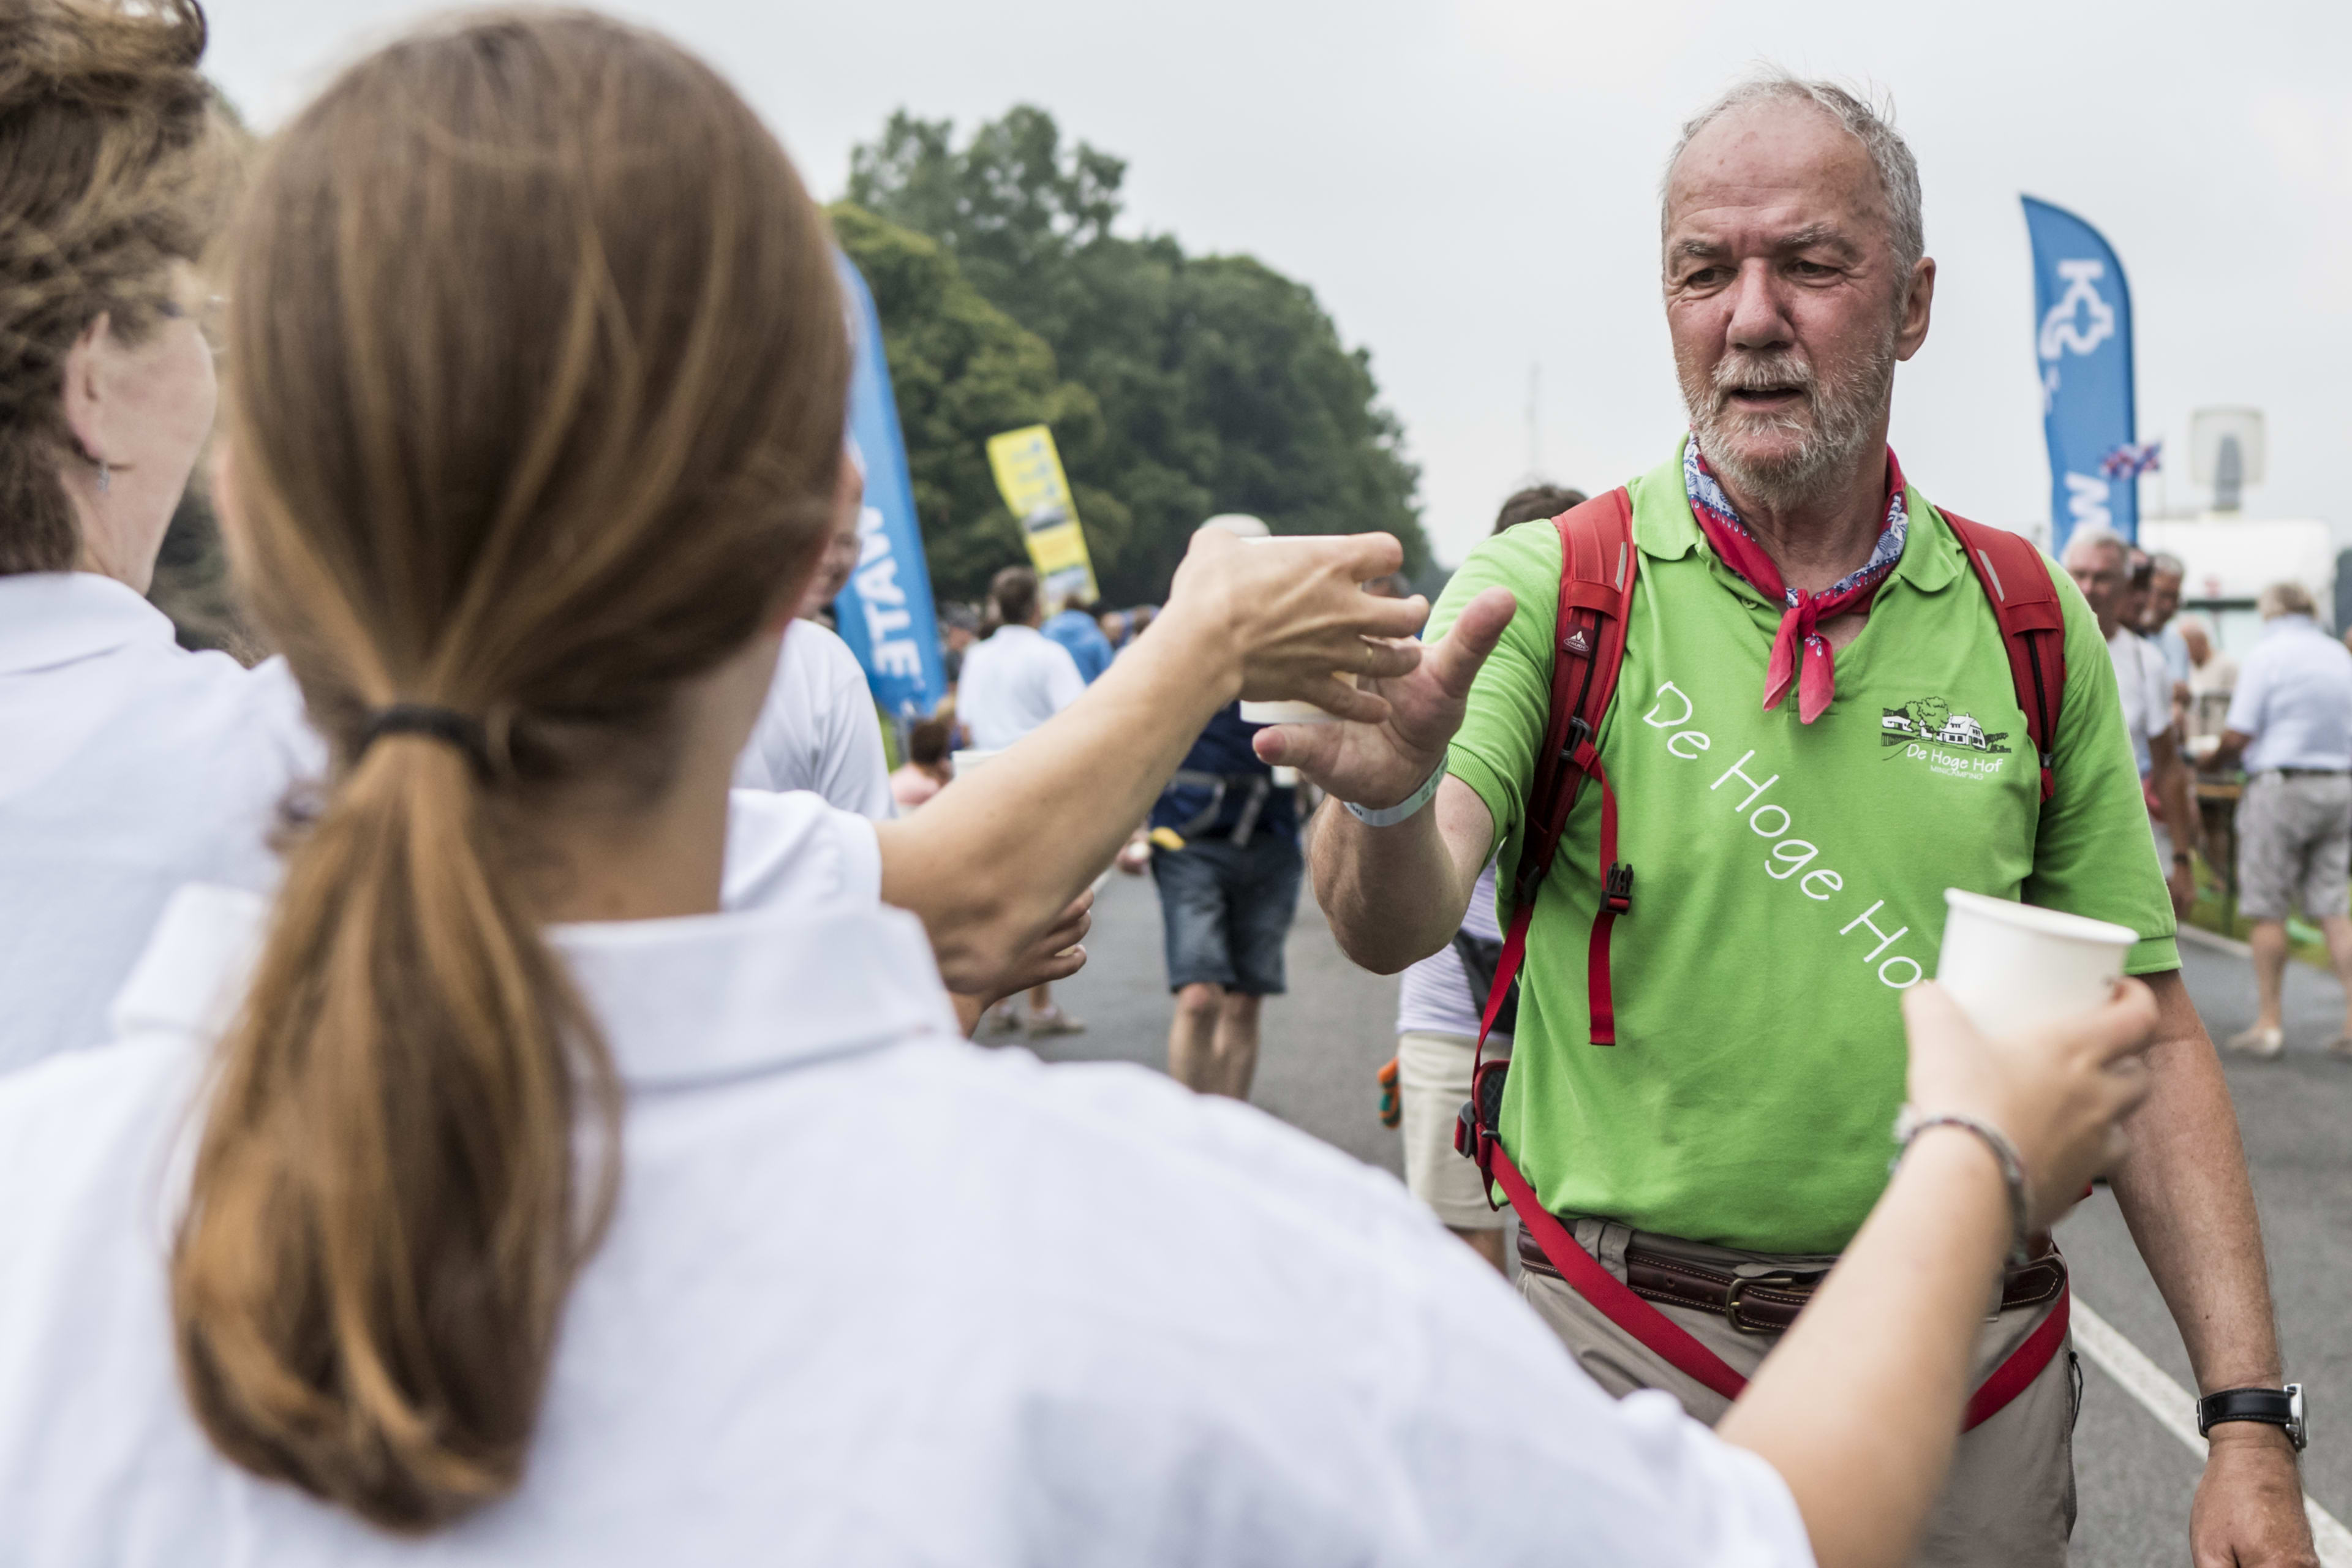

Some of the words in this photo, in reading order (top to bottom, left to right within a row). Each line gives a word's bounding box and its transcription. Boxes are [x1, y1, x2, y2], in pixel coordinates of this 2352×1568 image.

[1567, 639, 1586, 650] VAUDE
[1906, 743, 1928, 760] De
[1931, 748, 1969, 771] Hoge
[1972, 758, 2003, 773] Hof
[1930, 764, 1984, 780] MINICAMPING
[1643, 680, 1711, 760] De
[1709, 749, 1844, 900] Hoge
[1839, 899, 1931, 989] Ho
